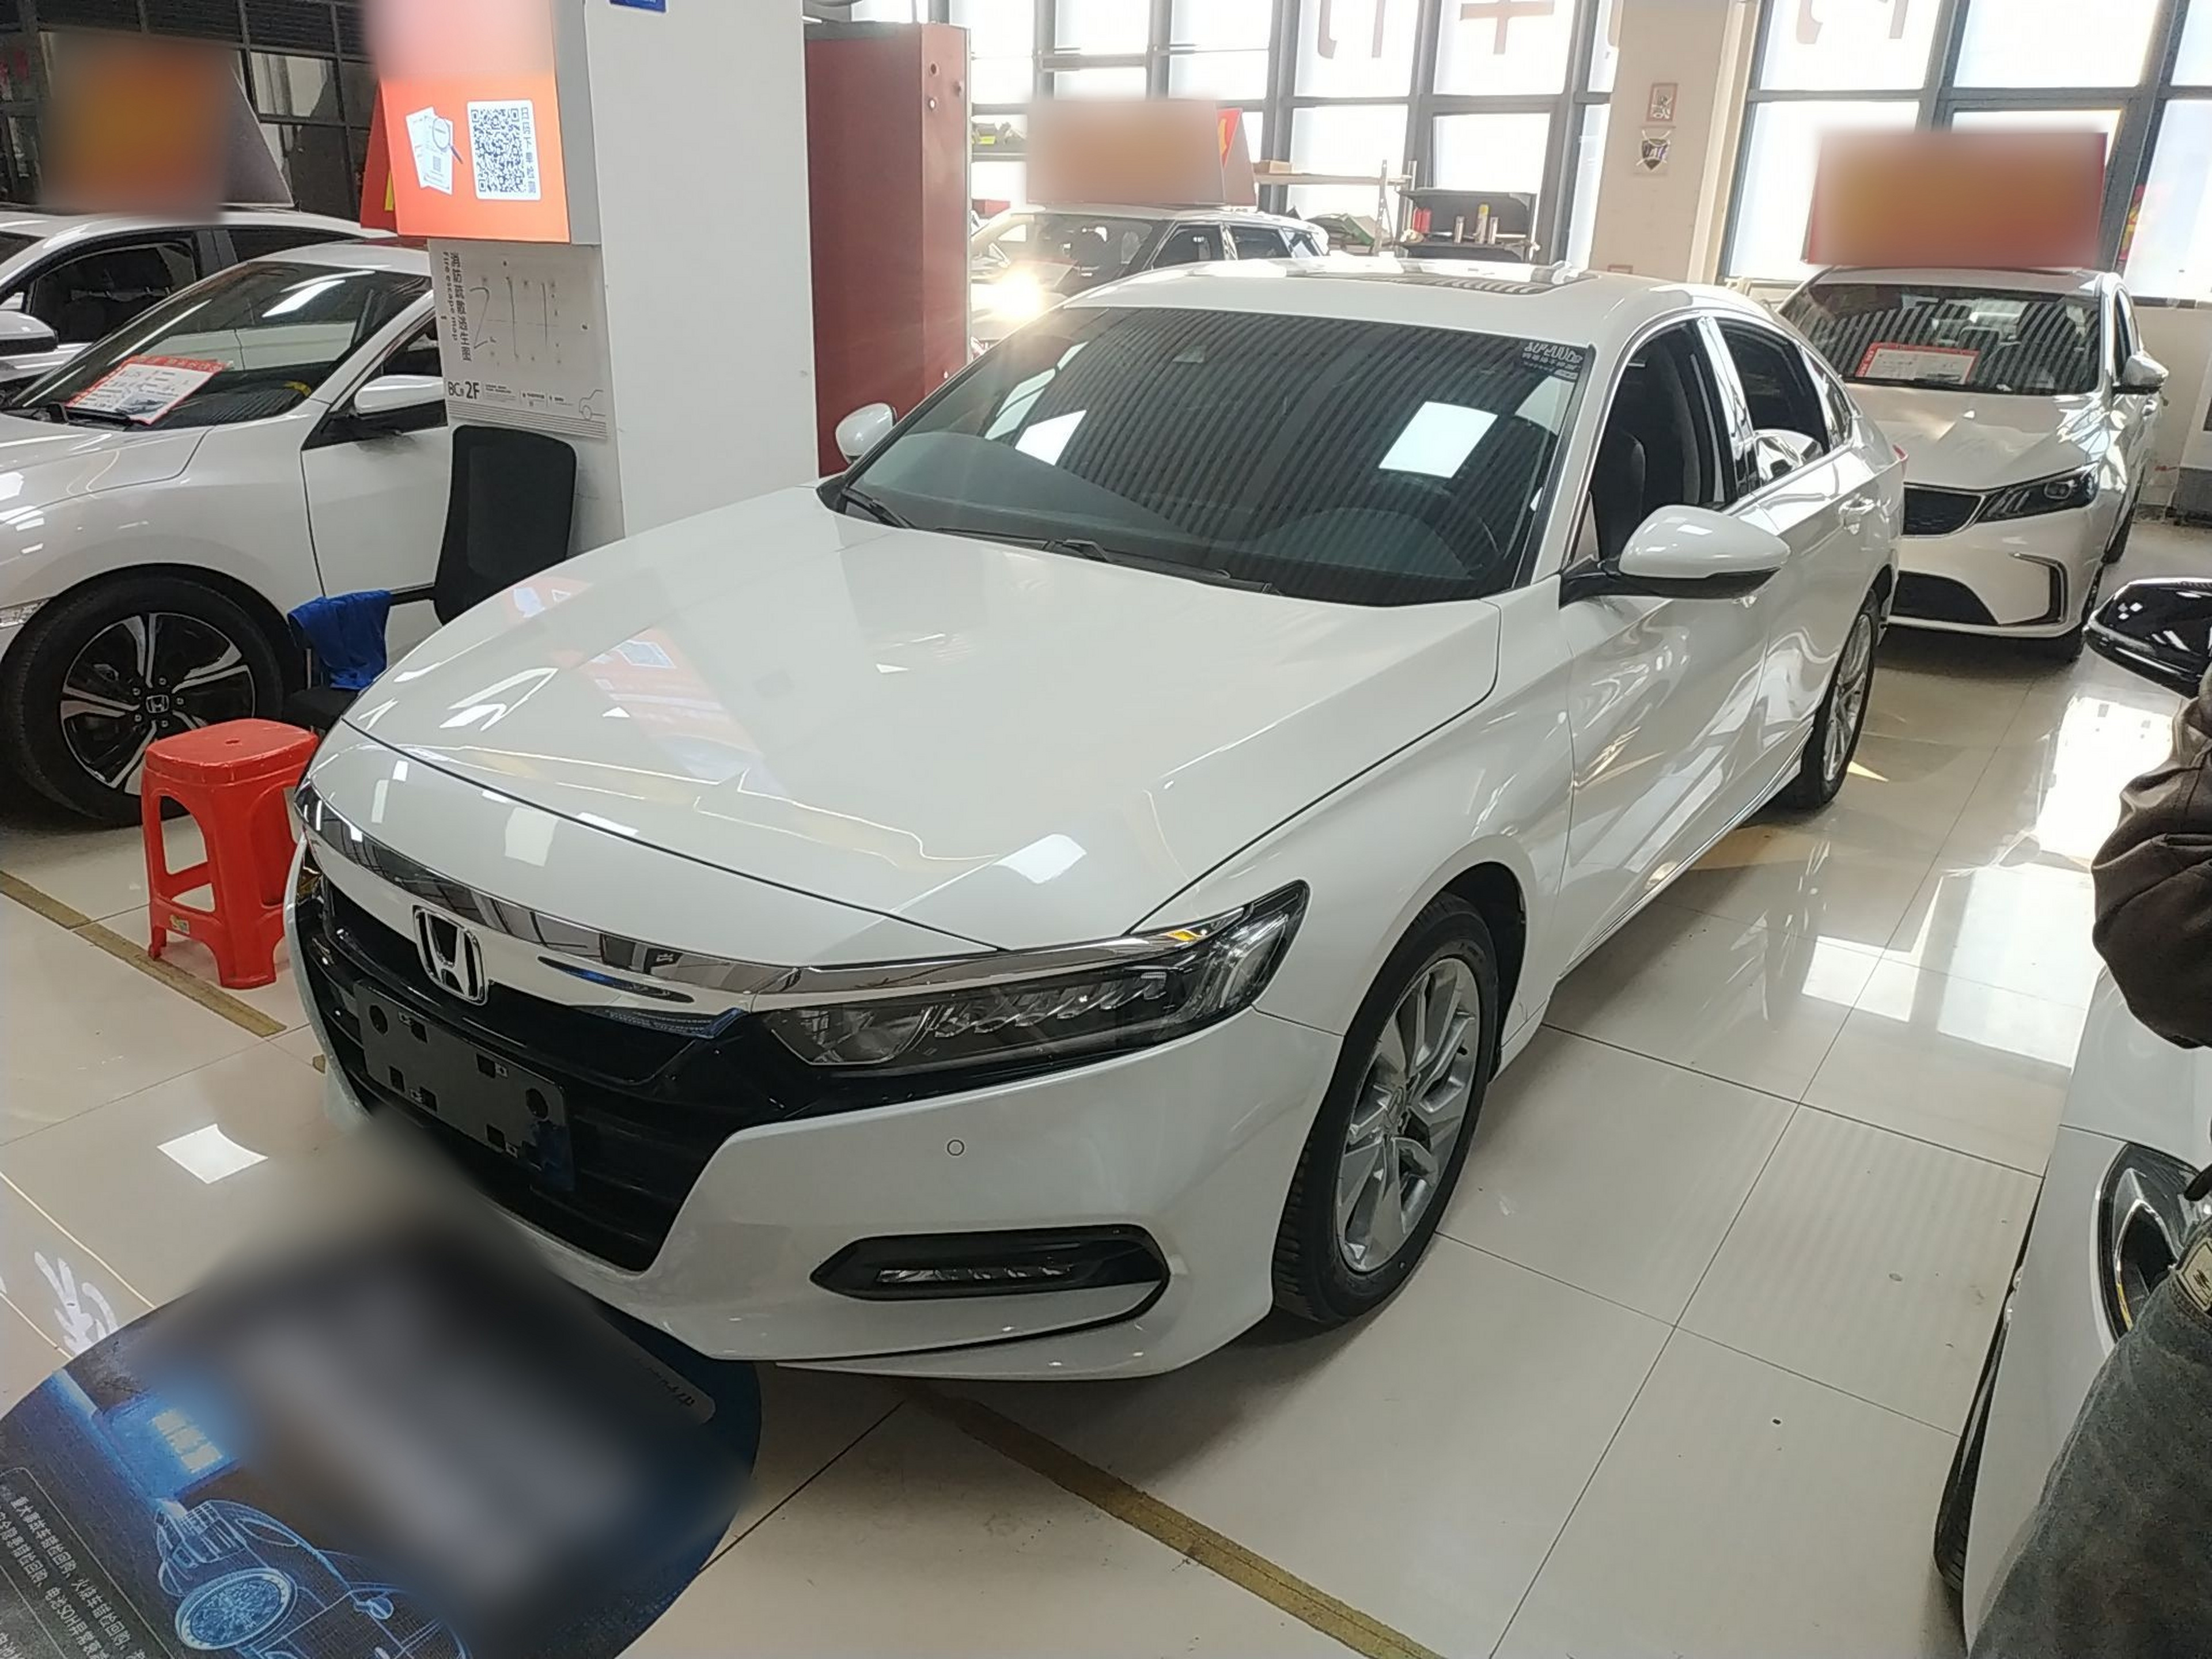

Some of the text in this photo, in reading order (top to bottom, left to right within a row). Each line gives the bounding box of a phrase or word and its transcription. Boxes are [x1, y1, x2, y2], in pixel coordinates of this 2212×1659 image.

[445, 274, 455, 314] escape
[450, 316, 459, 342] map
[465, 381, 480, 400] 2F
